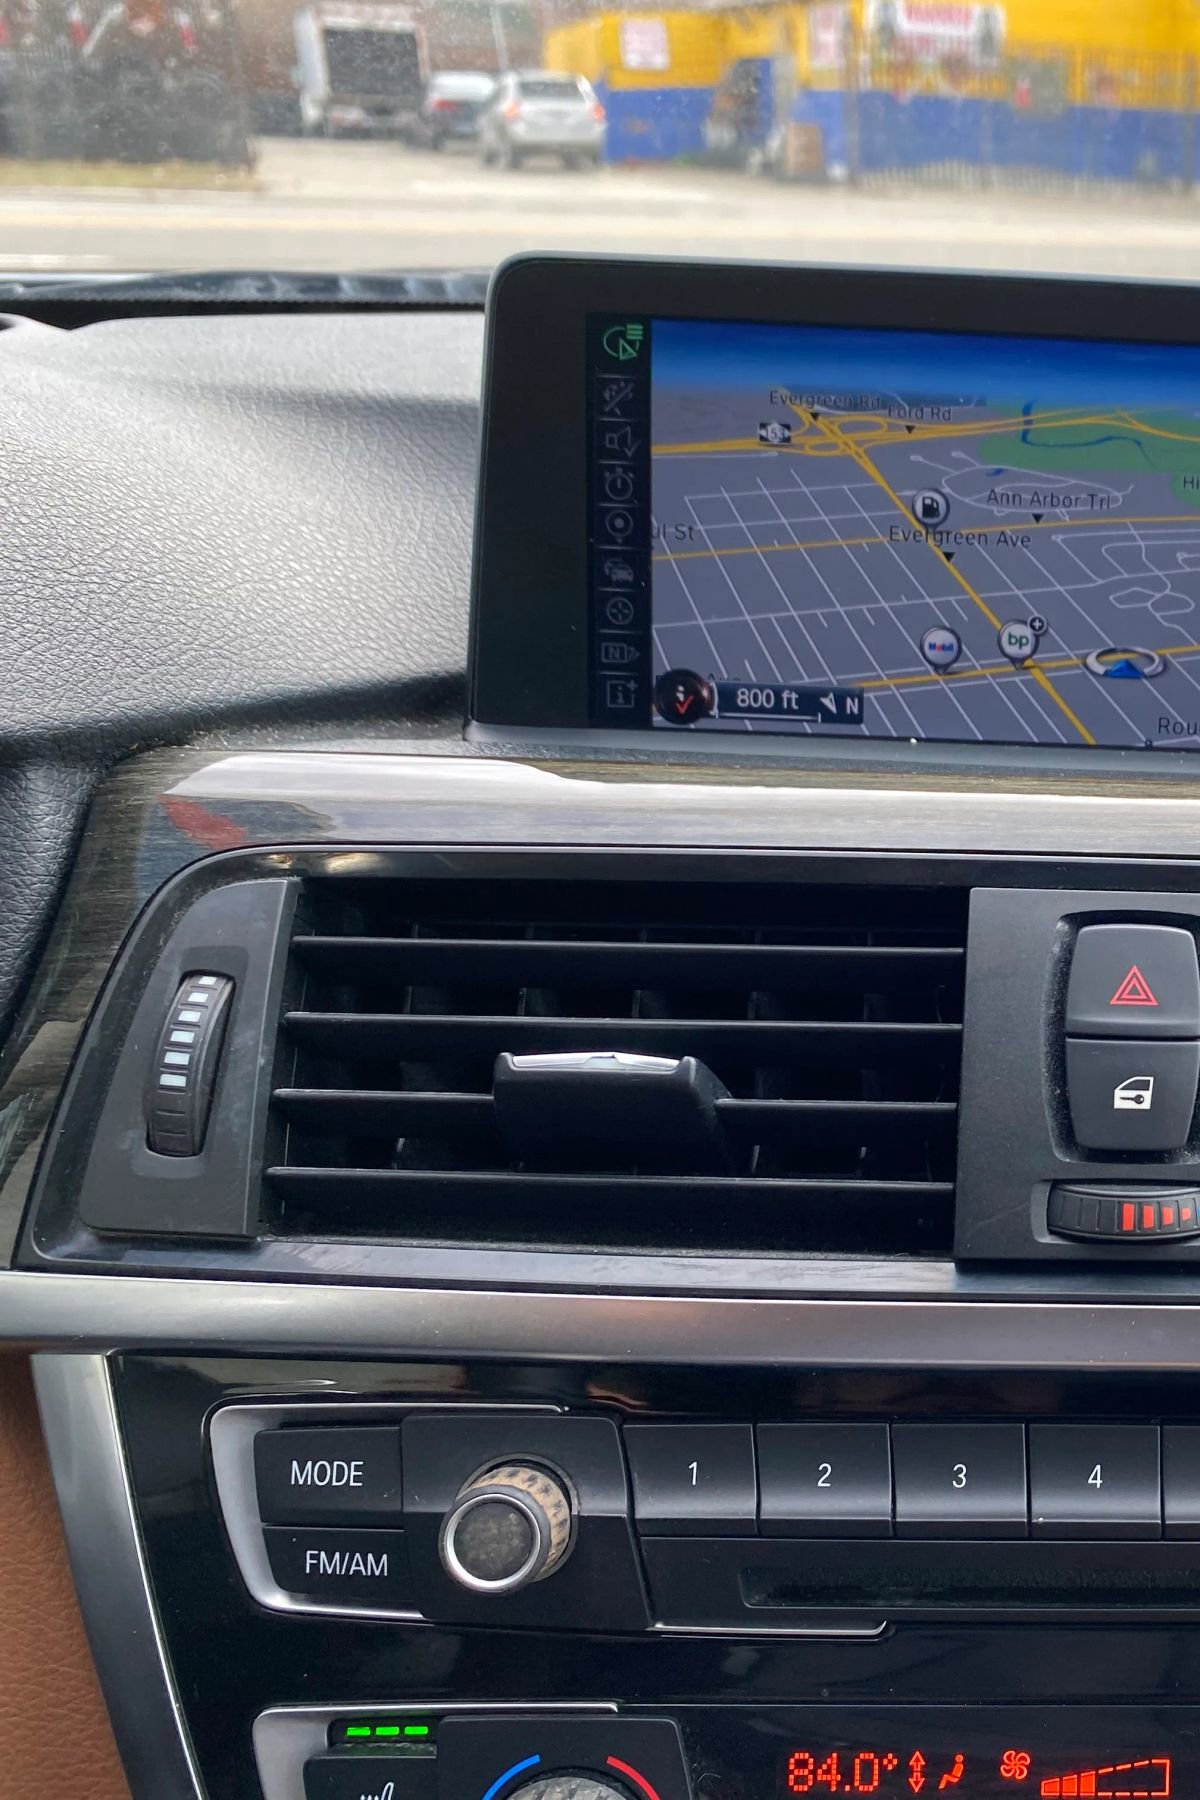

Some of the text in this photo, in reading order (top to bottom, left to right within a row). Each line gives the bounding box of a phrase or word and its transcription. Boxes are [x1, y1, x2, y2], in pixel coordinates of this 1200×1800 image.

[769, 390, 881, 409] Evergreen Rd
[888, 404, 952, 422] Ford Rd
[986, 489, 1112, 510] Ann Arbor Trl
[674, 522, 695, 541] St
[889, 525, 1031, 549] Evergreen Ave
[1007, 632, 1030, 650] bp
[736, 687, 799, 710] 800 ft
[846, 697, 859, 715] N
[290, 1460, 364, 1487] MODE
[688, 1461, 698, 1486] 1
[817, 1463, 832, 1488] 2
[952, 1463, 968, 1489] 3
[1087, 1464, 1103, 1489] 4
[305, 1550, 389, 1577] FM/AM
